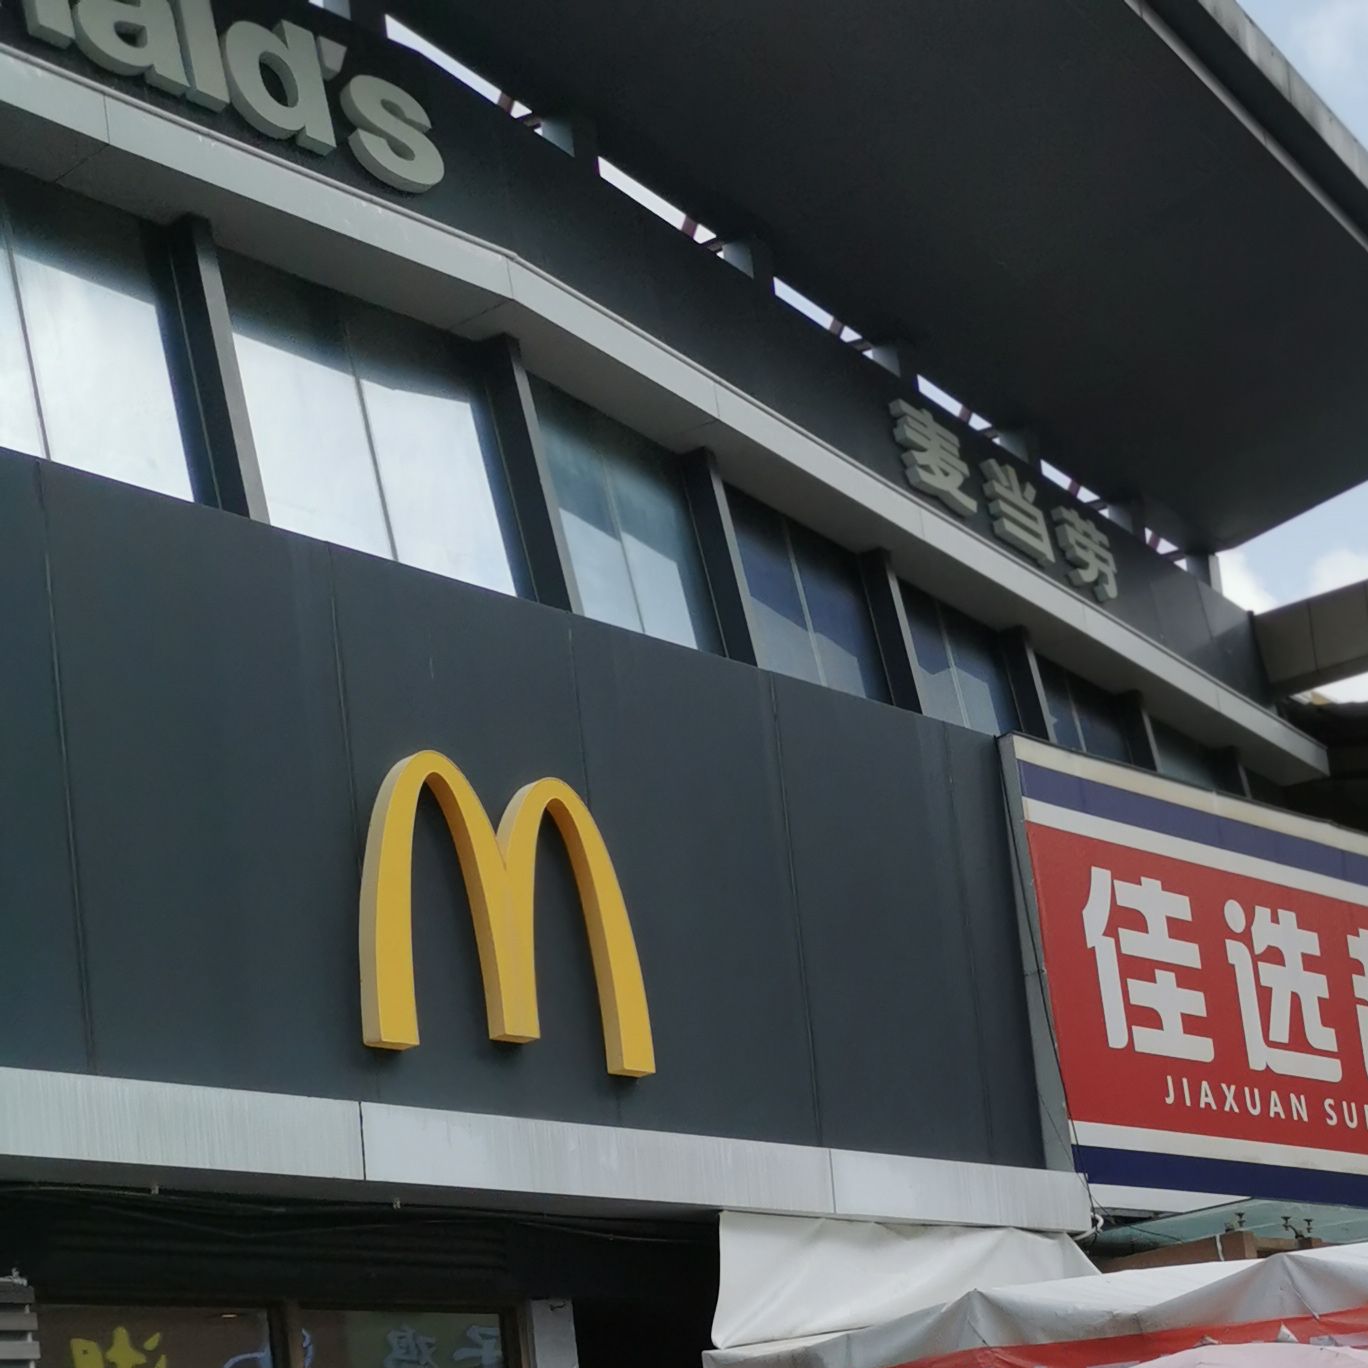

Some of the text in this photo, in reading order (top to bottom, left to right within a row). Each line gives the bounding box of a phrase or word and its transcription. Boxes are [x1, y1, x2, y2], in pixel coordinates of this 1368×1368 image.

[888, 398, 1119, 602] 麦当劳
[358, 749, 656, 1079] M
[1164, 1074, 1308, 1123] JIAXUAN
